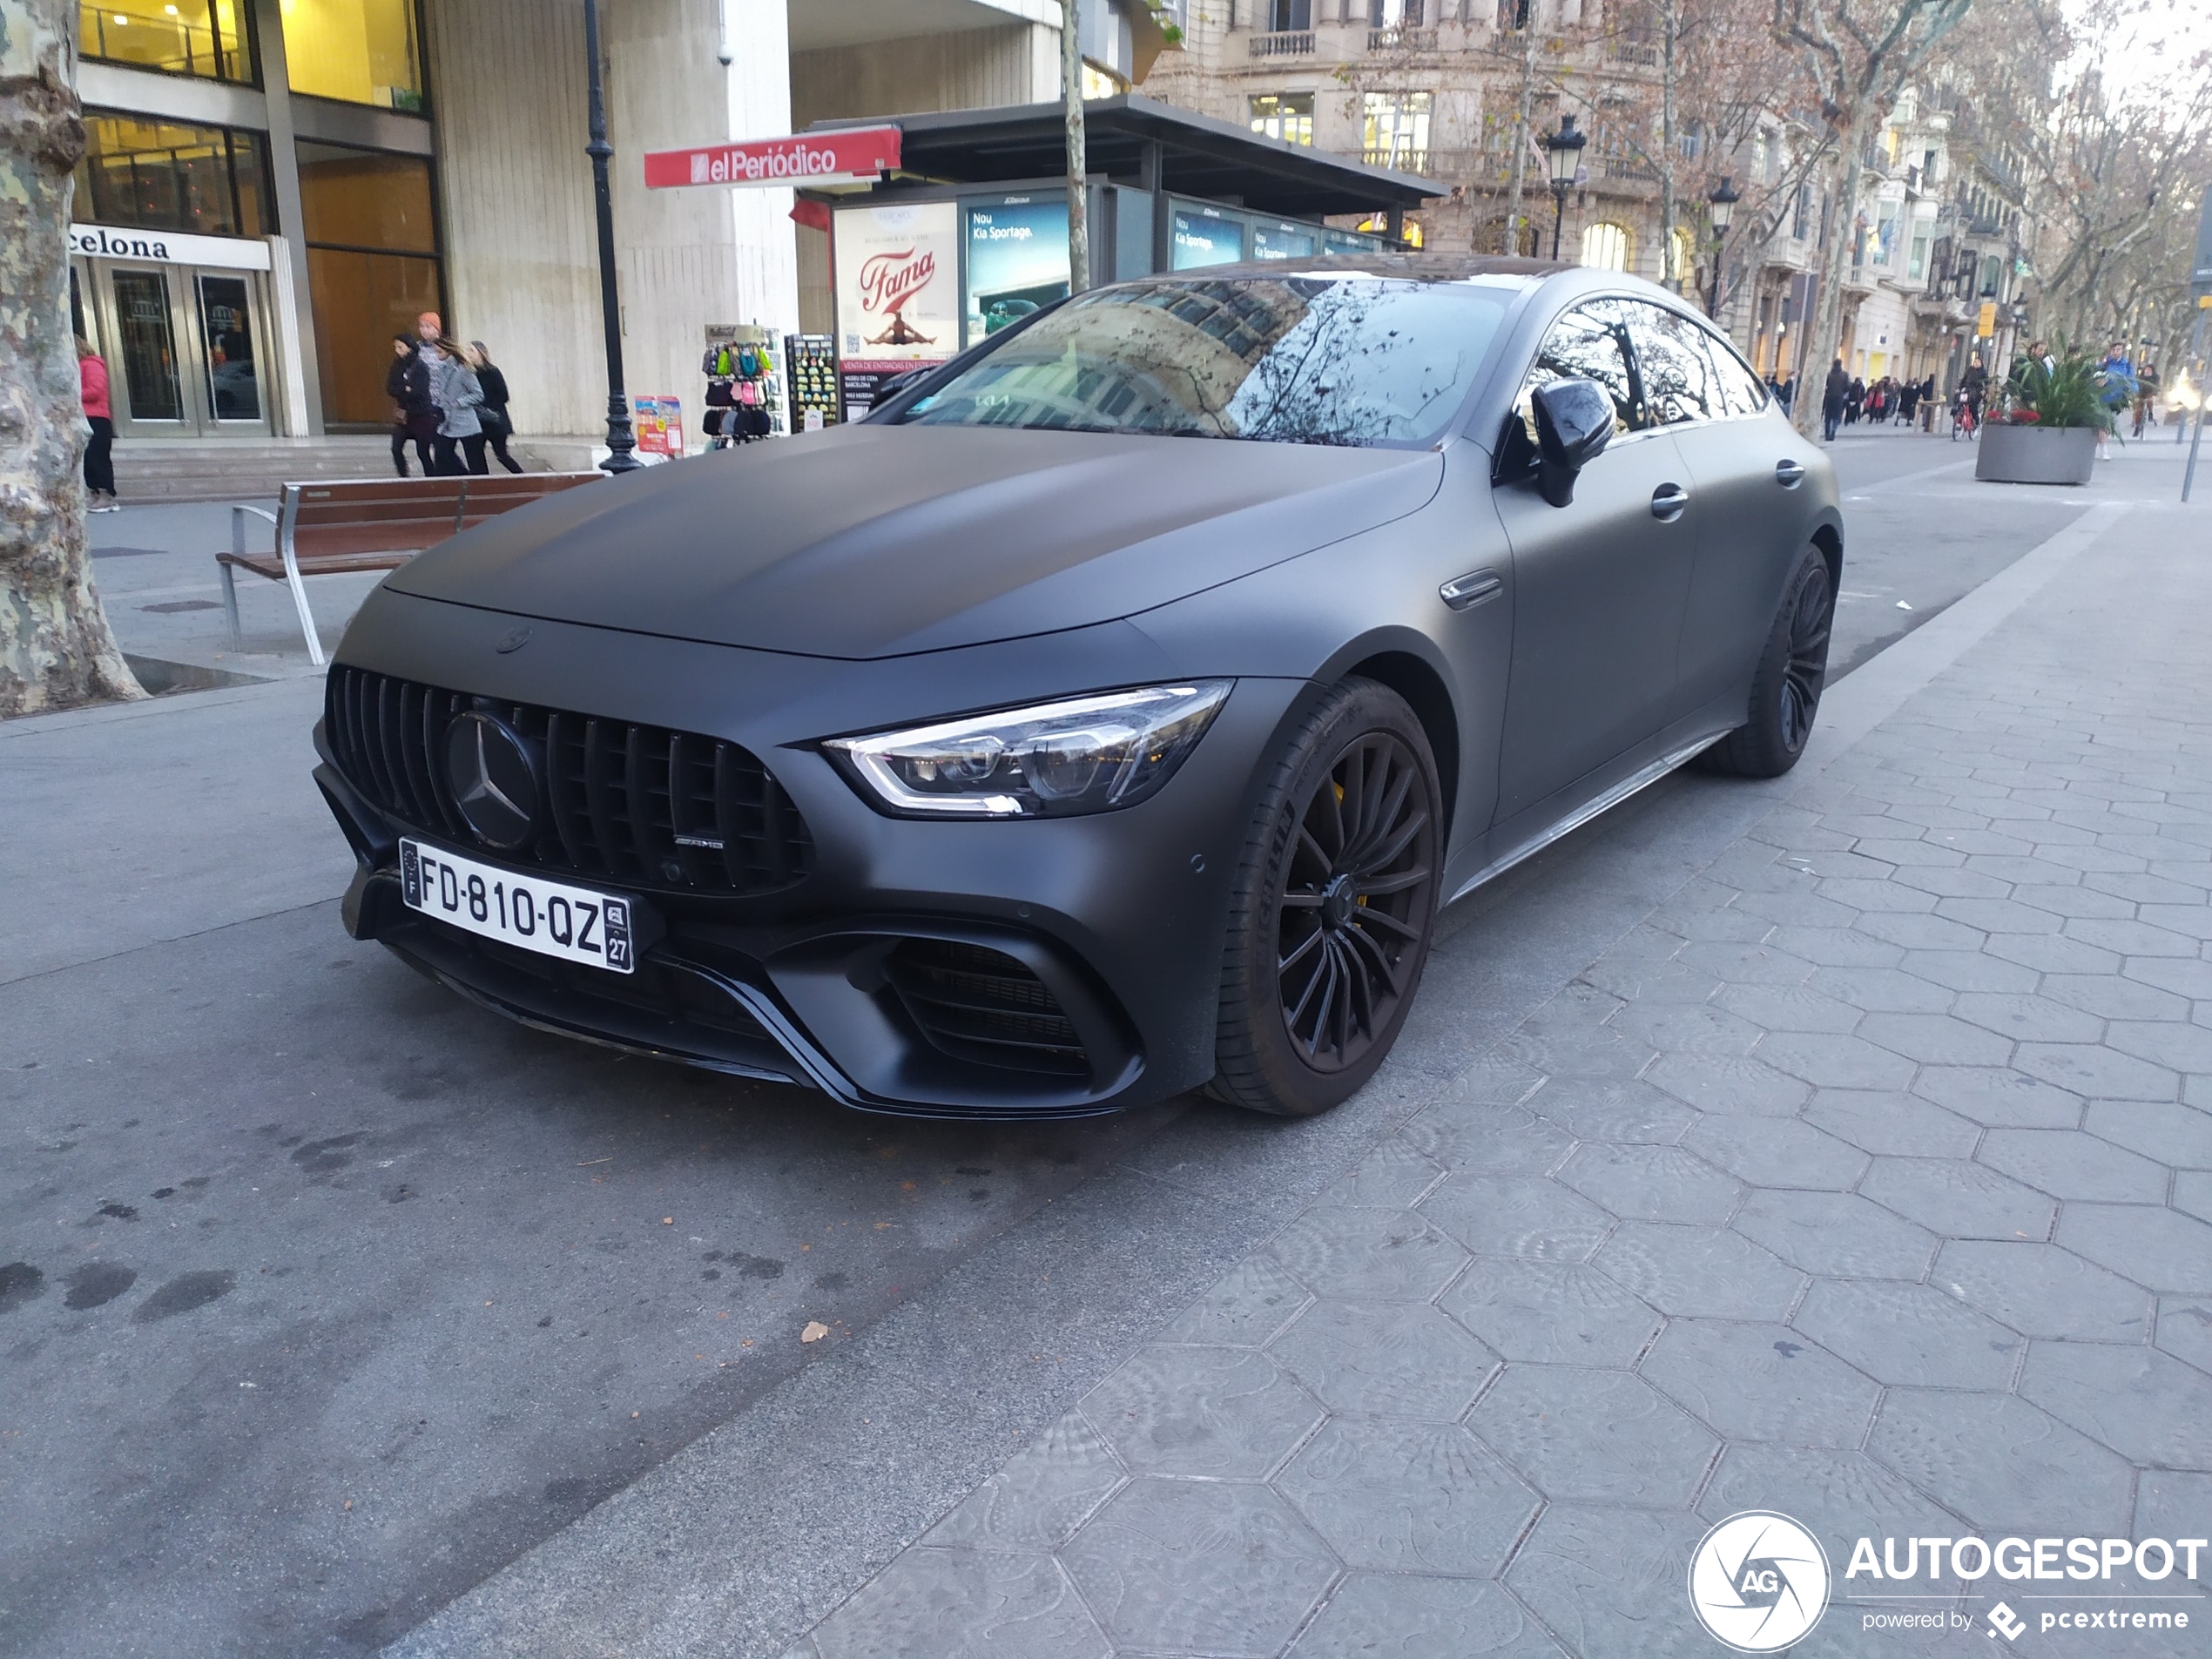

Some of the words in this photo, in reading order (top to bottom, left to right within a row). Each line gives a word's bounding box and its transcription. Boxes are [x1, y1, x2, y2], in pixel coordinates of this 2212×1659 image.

[711, 152, 729, 180] el
[732, 144, 836, 179] Periódico
[973, 212, 992, 225] Nou
[1176, 216, 1189, 230] Nou
[973, 227, 988, 239] Kia
[1175, 232, 1186, 244] Kia
[1255, 233, 1267, 244] Nou
[860, 245, 935, 315] Fama
[408, 881, 415, 894] F
[609, 938, 627, 961] 27
